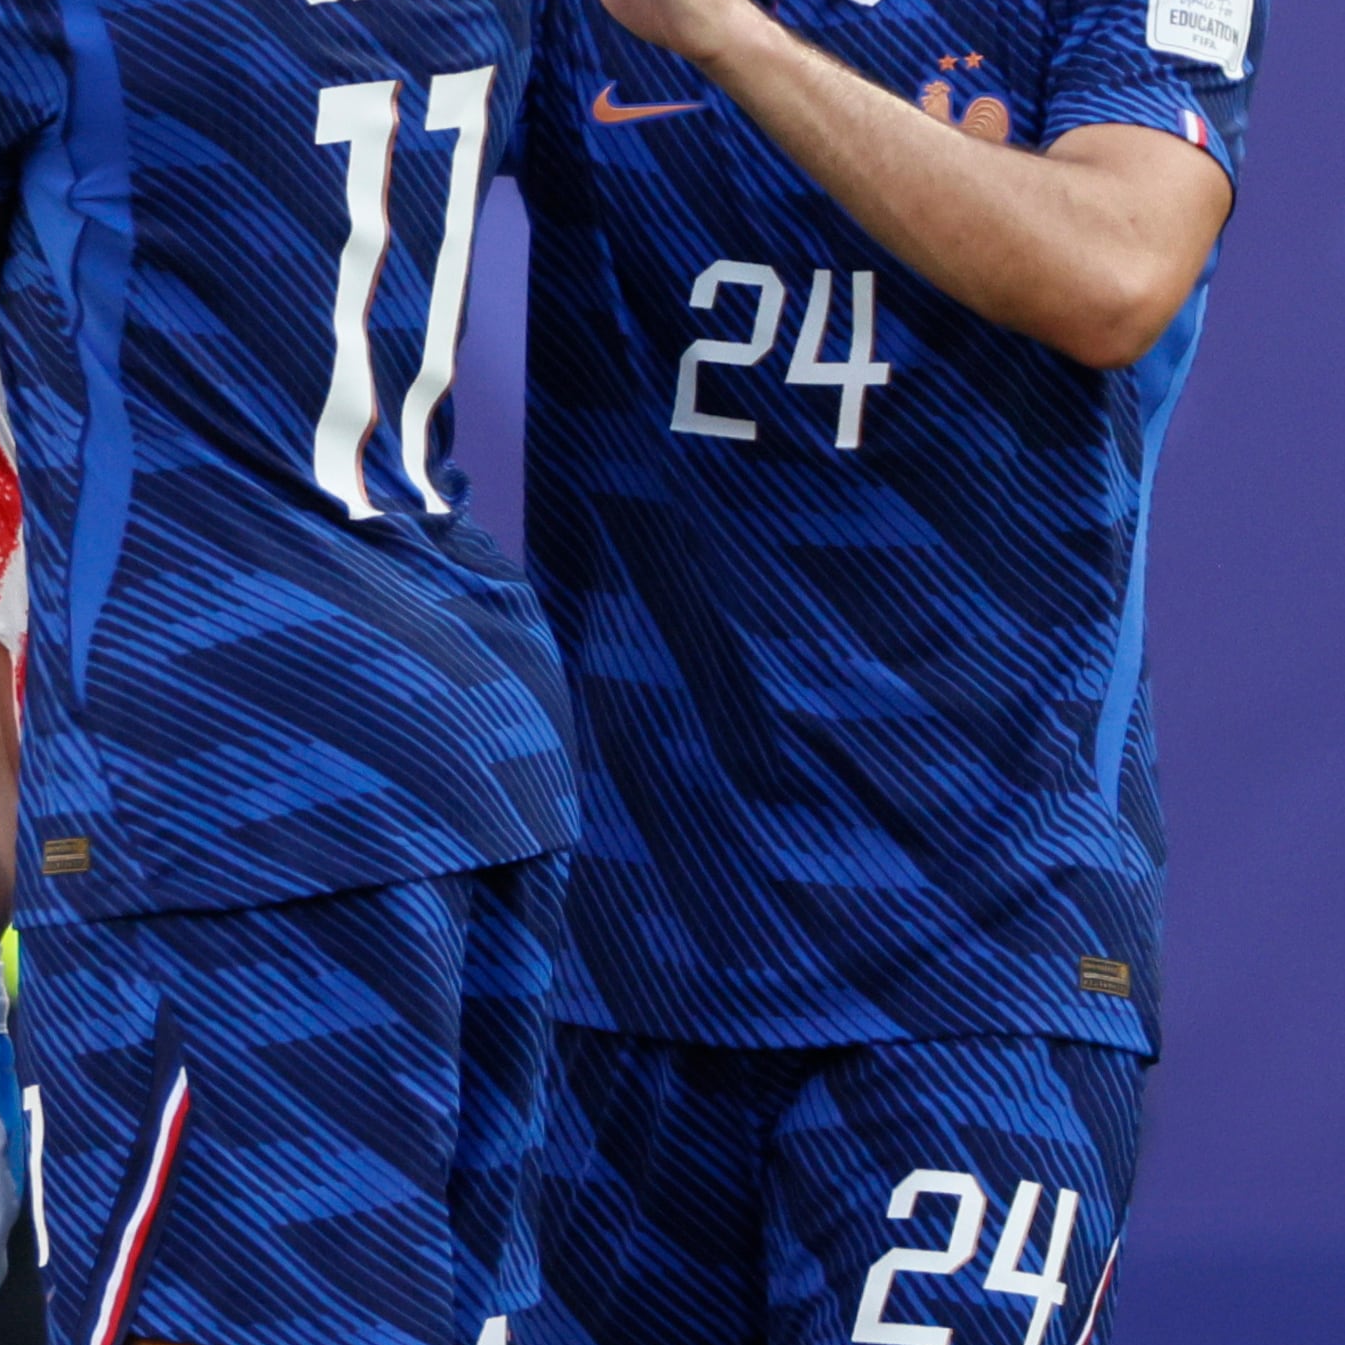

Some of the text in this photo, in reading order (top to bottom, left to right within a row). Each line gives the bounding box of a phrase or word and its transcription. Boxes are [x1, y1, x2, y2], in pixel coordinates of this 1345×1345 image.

[1170, 8, 1240, 49] EDUCATION
[1192, 33, 1217, 51] FIFA
[315, 64, 496, 520] 11
[669, 259, 892, 449] 24
